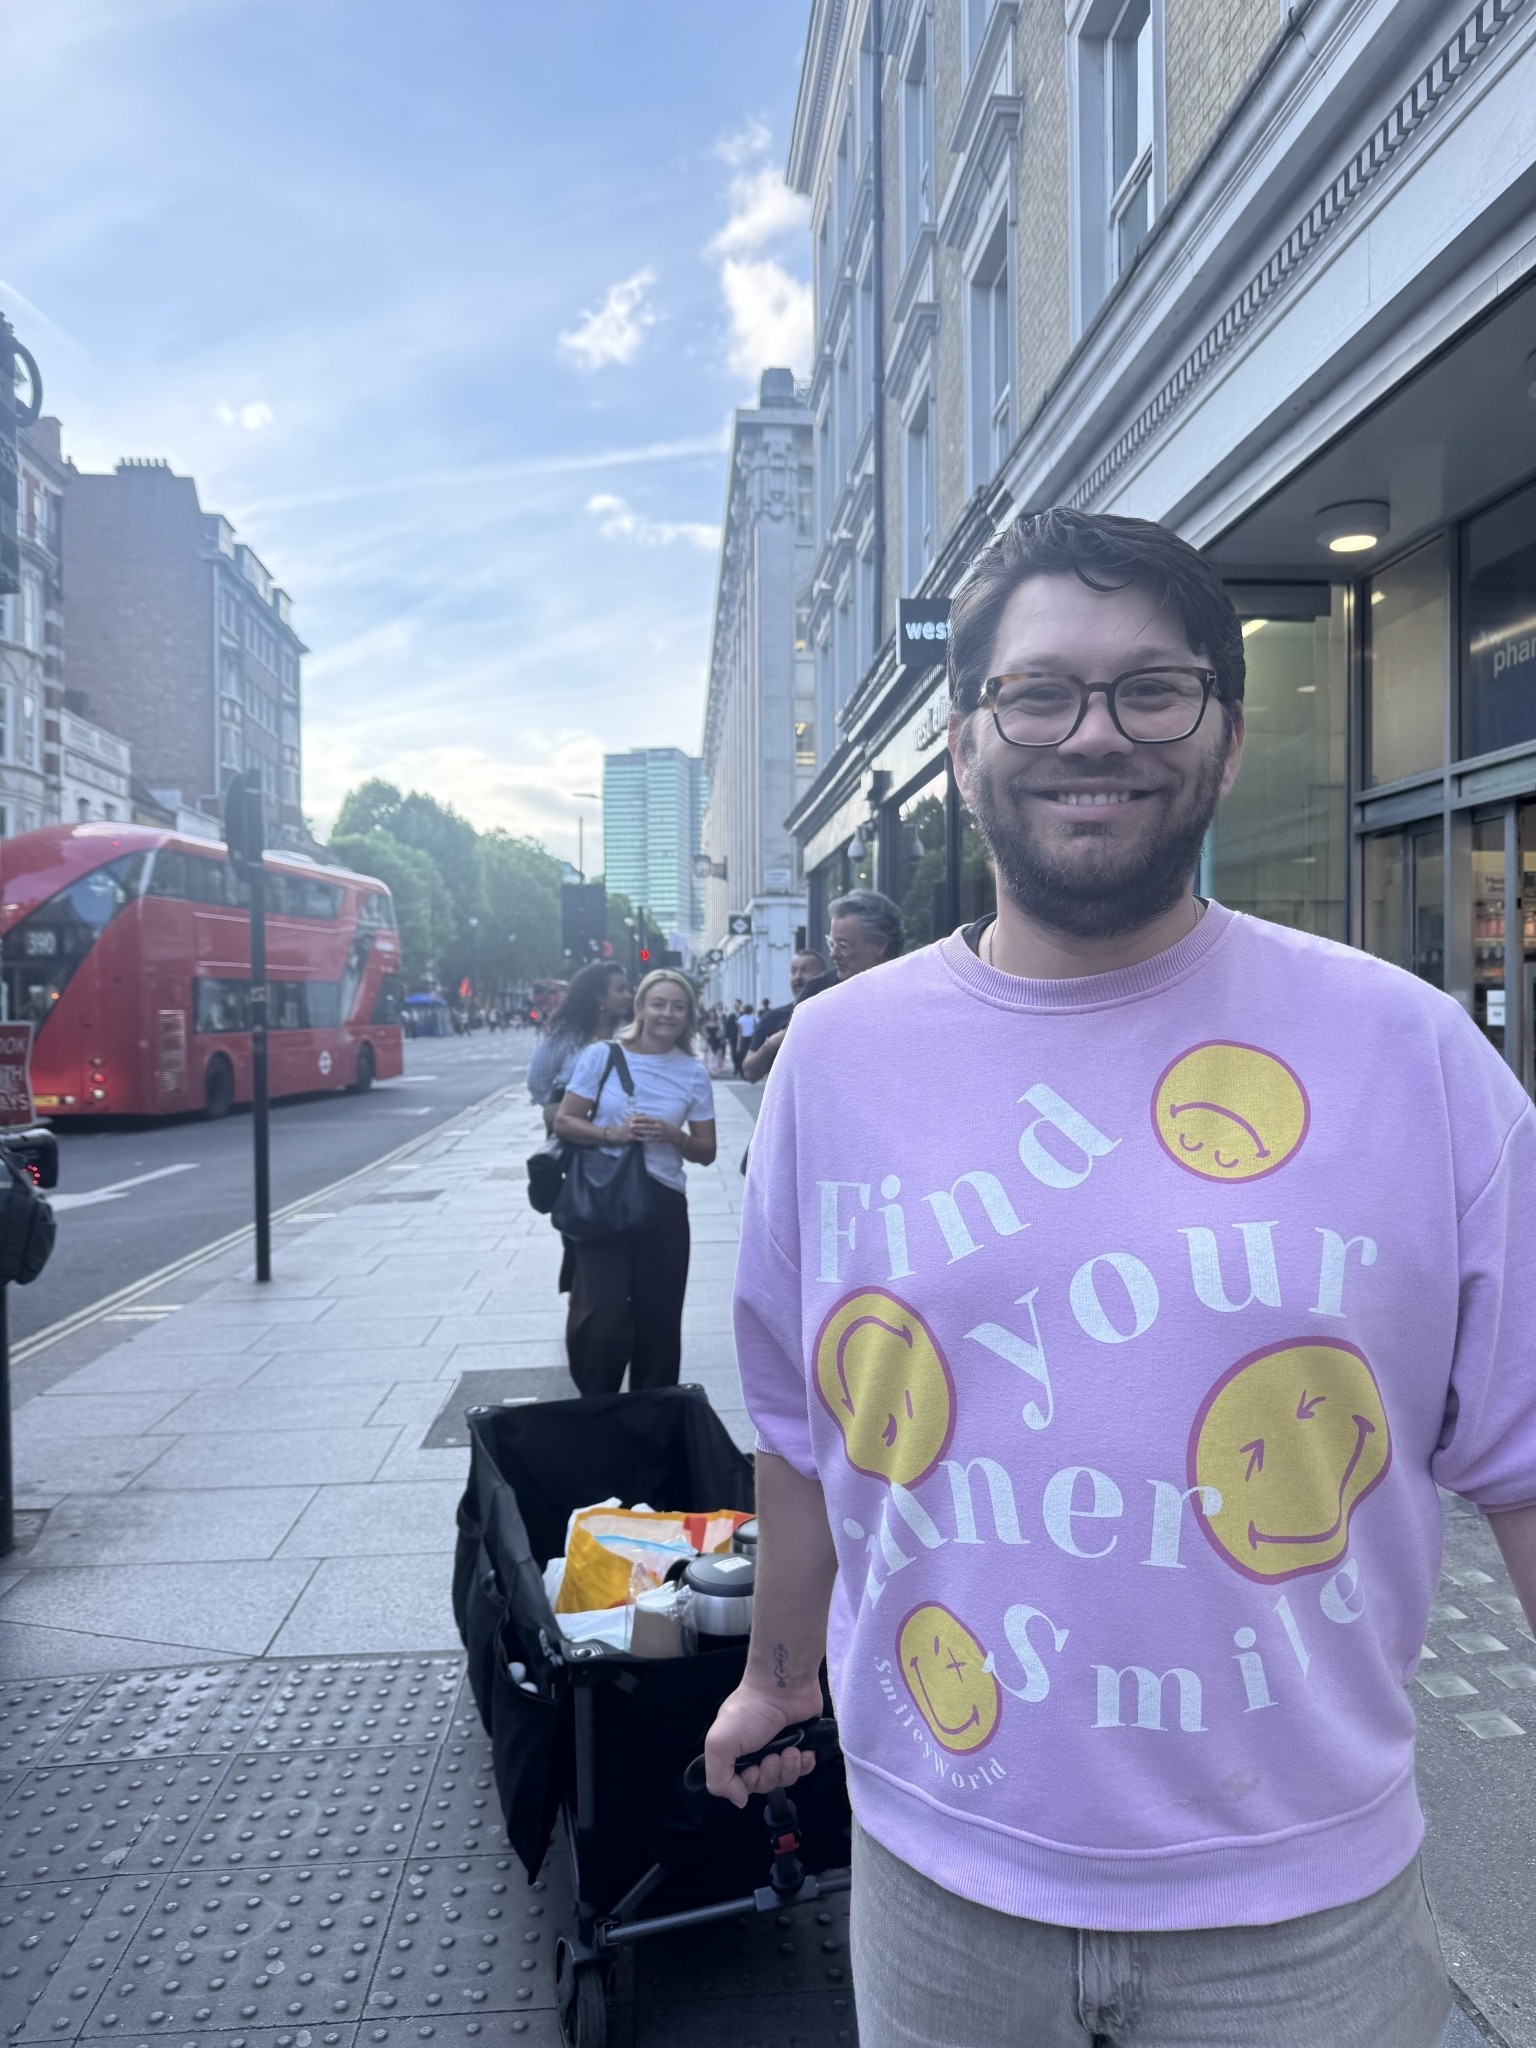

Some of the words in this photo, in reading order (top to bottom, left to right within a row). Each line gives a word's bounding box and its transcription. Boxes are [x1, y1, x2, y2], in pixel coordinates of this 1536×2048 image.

[816, 1083, 1123, 1284] Find
[963, 1220, 1378, 1431] your
[981, 1558, 1366, 1733] Smile
